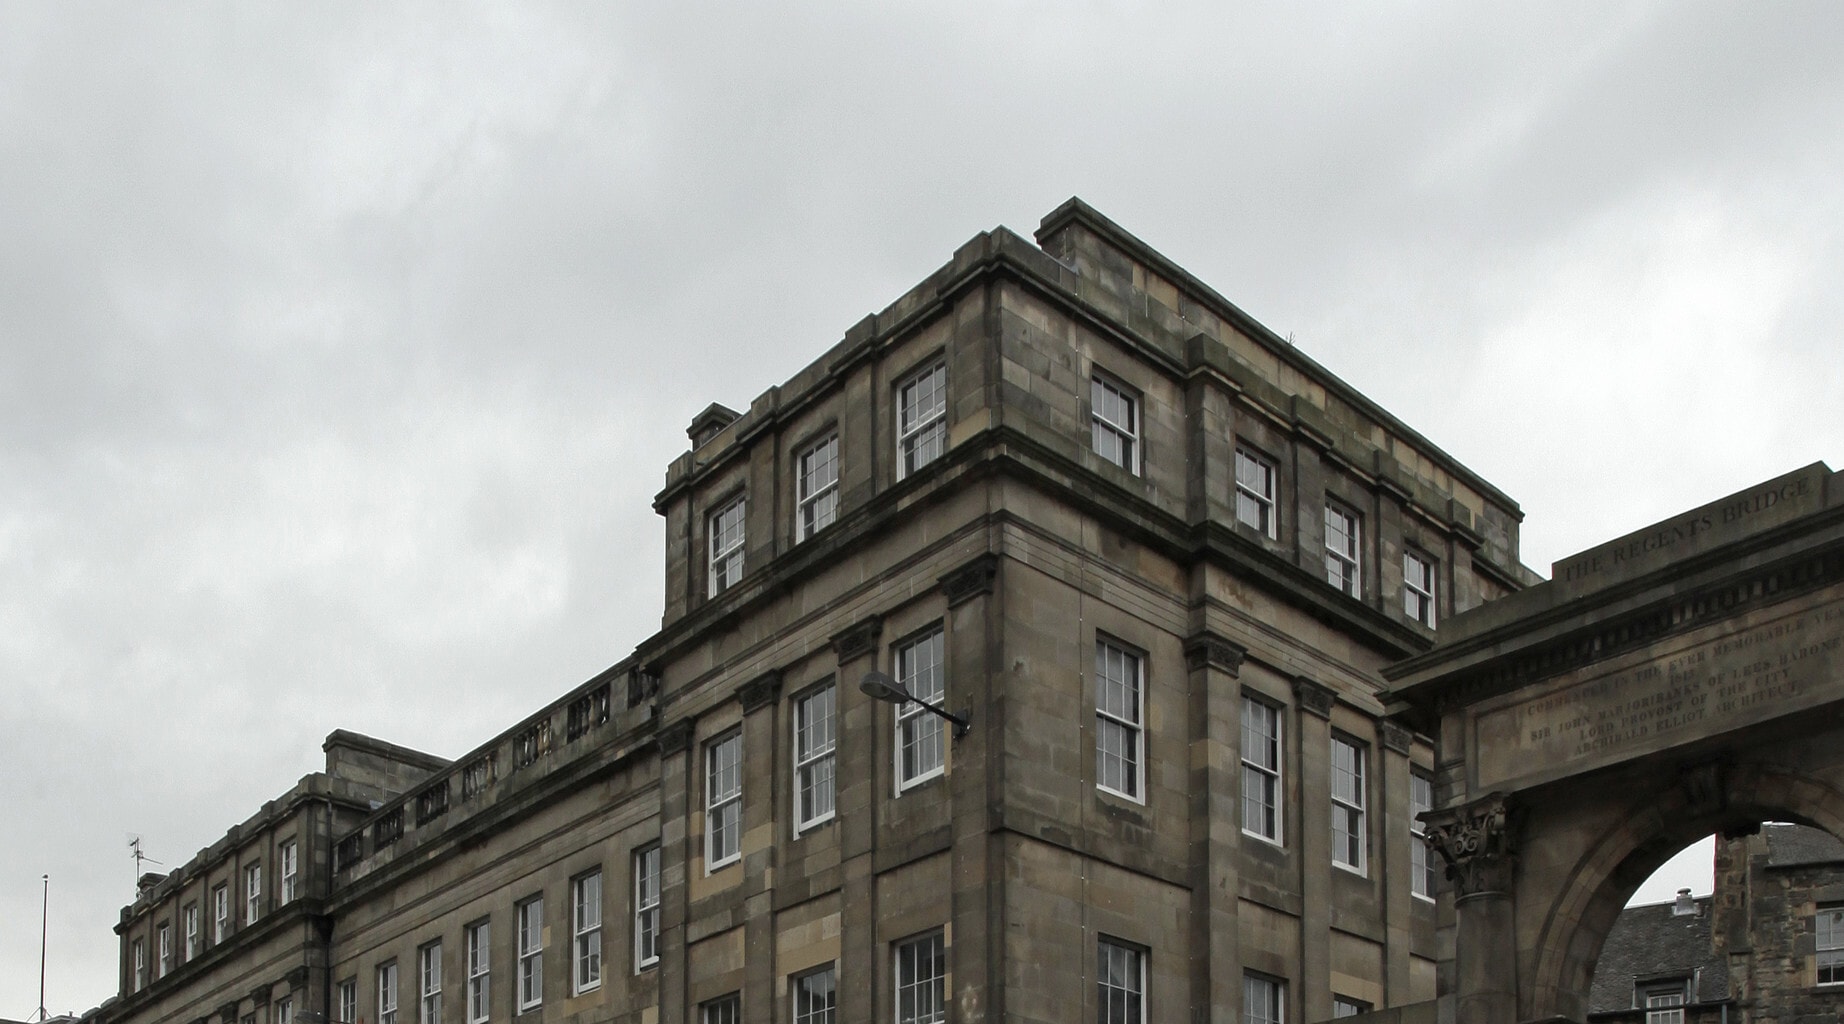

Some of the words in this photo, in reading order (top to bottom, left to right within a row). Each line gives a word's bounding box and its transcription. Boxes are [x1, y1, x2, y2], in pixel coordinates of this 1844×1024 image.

[1563, 557, 1604, 582] THE
[1722, 477, 1811, 524] BRIDGE
[1669, 651, 1705, 674] EVER
[1713, 619, 1805, 657] MEMORABLE
[1531, 726, 1551, 741] SIR
[1559, 715, 1590, 734] JOHN
[1708, 673, 1726, 687] OF
[1576, 725, 1648, 755] ARCHIBALD
[1656, 708, 1705, 732] ELLIOT
[1580, 722, 1614, 740] LORD
[1621, 701, 1683, 728] PROVOST
[1691, 693, 1708, 706] OF
[1718, 681, 1746, 698] THE
[1755, 669, 1790, 687] CITY
